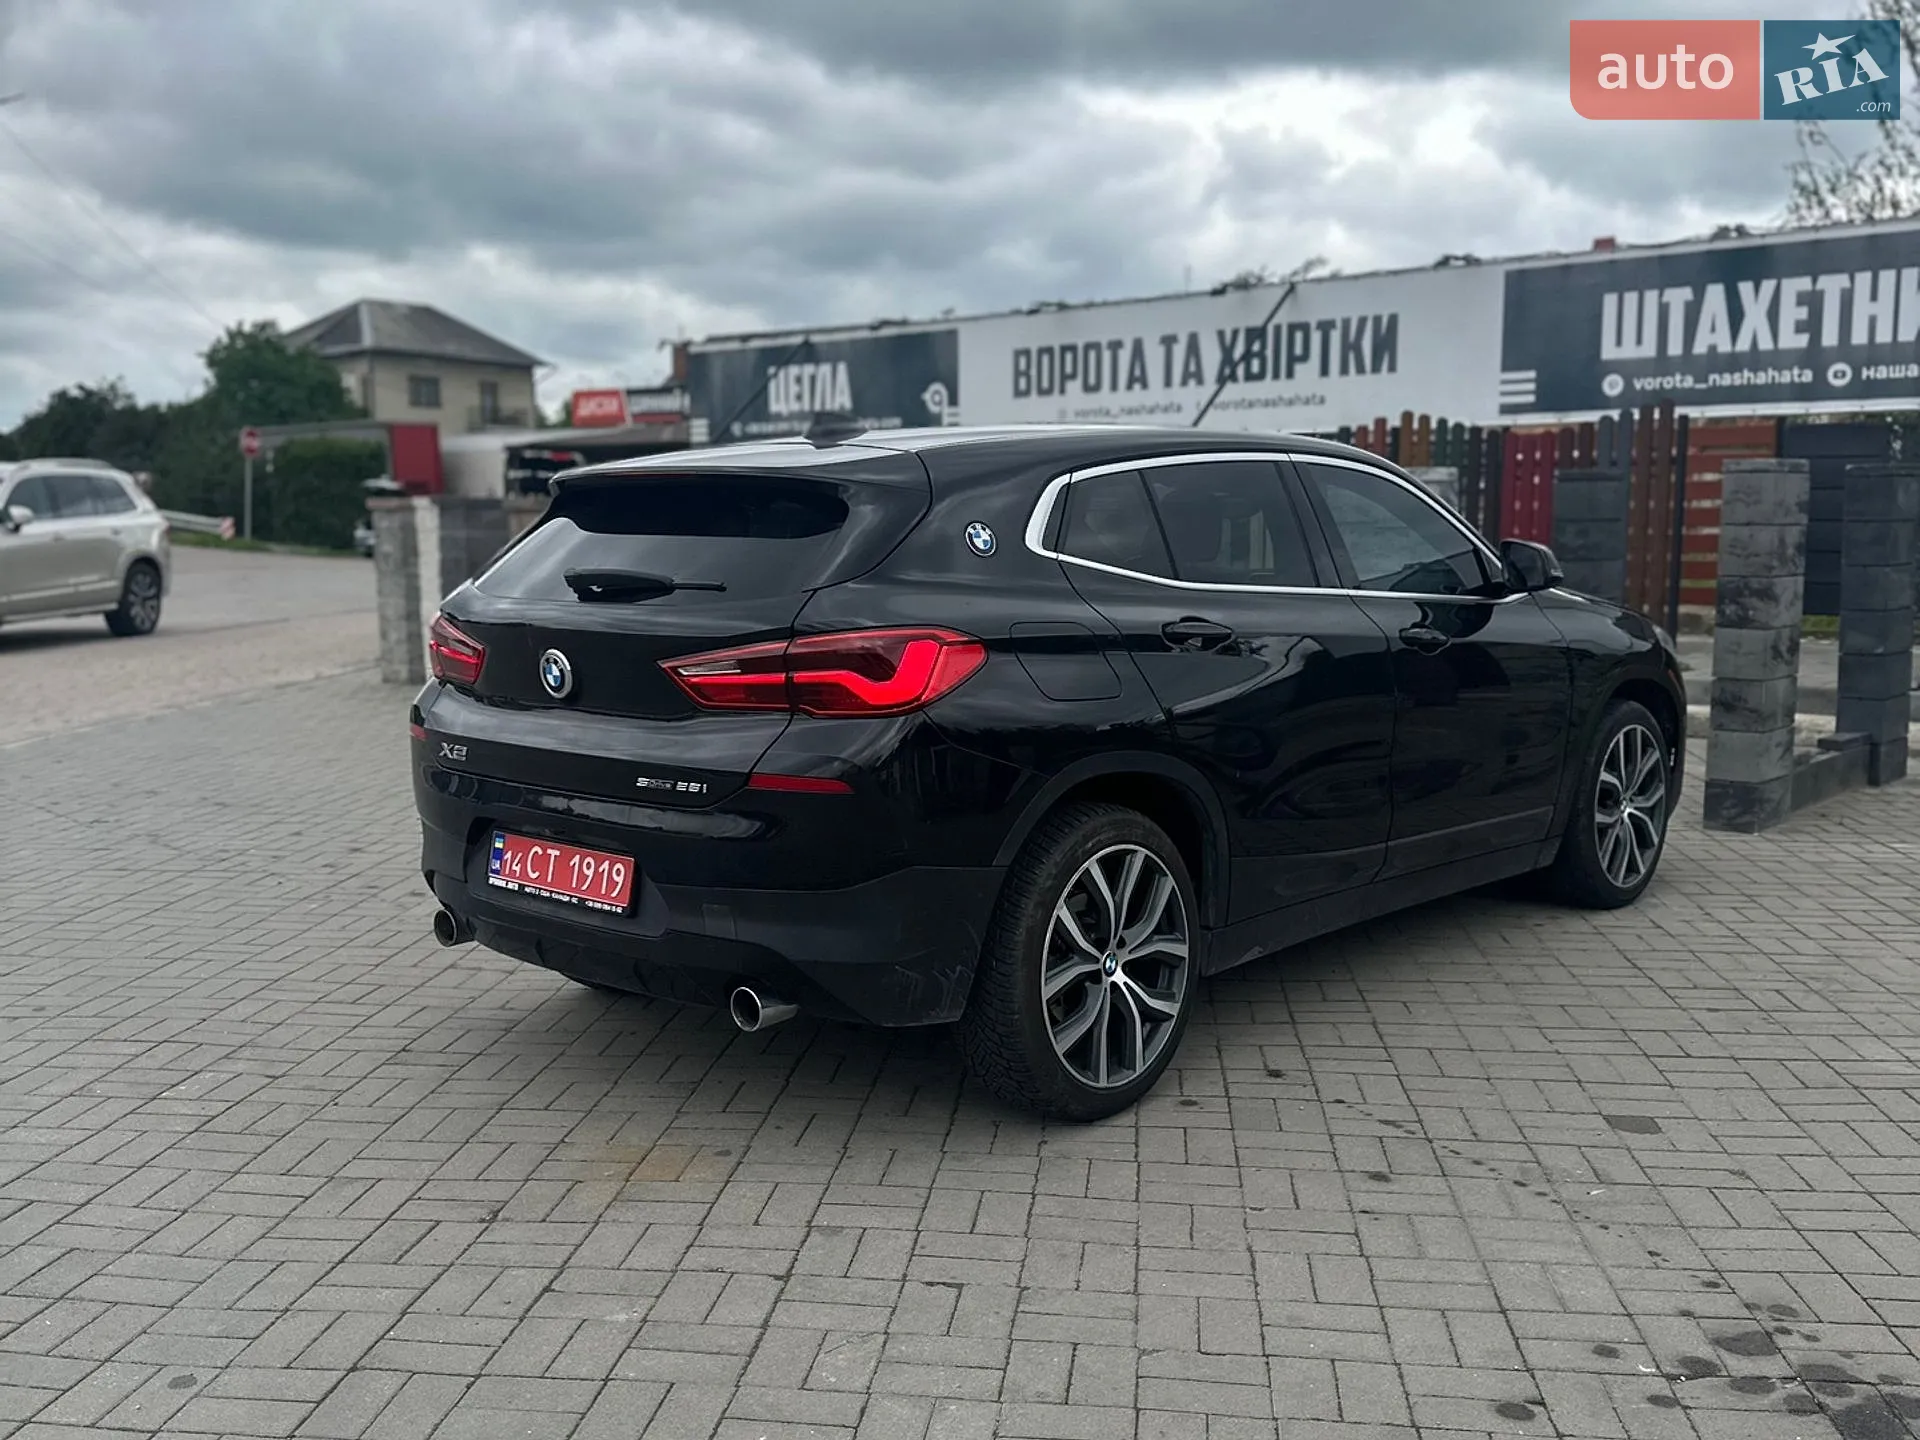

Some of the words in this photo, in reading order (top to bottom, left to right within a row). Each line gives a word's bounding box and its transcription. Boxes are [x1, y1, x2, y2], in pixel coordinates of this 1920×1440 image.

[1013, 337, 1148, 399] ВОРОТА
[1158, 331, 1205, 388] ТА
[1215, 313, 1399, 385] ХВІРТКИ
[767, 361, 853, 416] ЦЕГЛА
[1633, 366, 1813, 391] vorota_nashahata
[439, 742, 468, 761] X2
[569, 854, 626, 898] 1919
